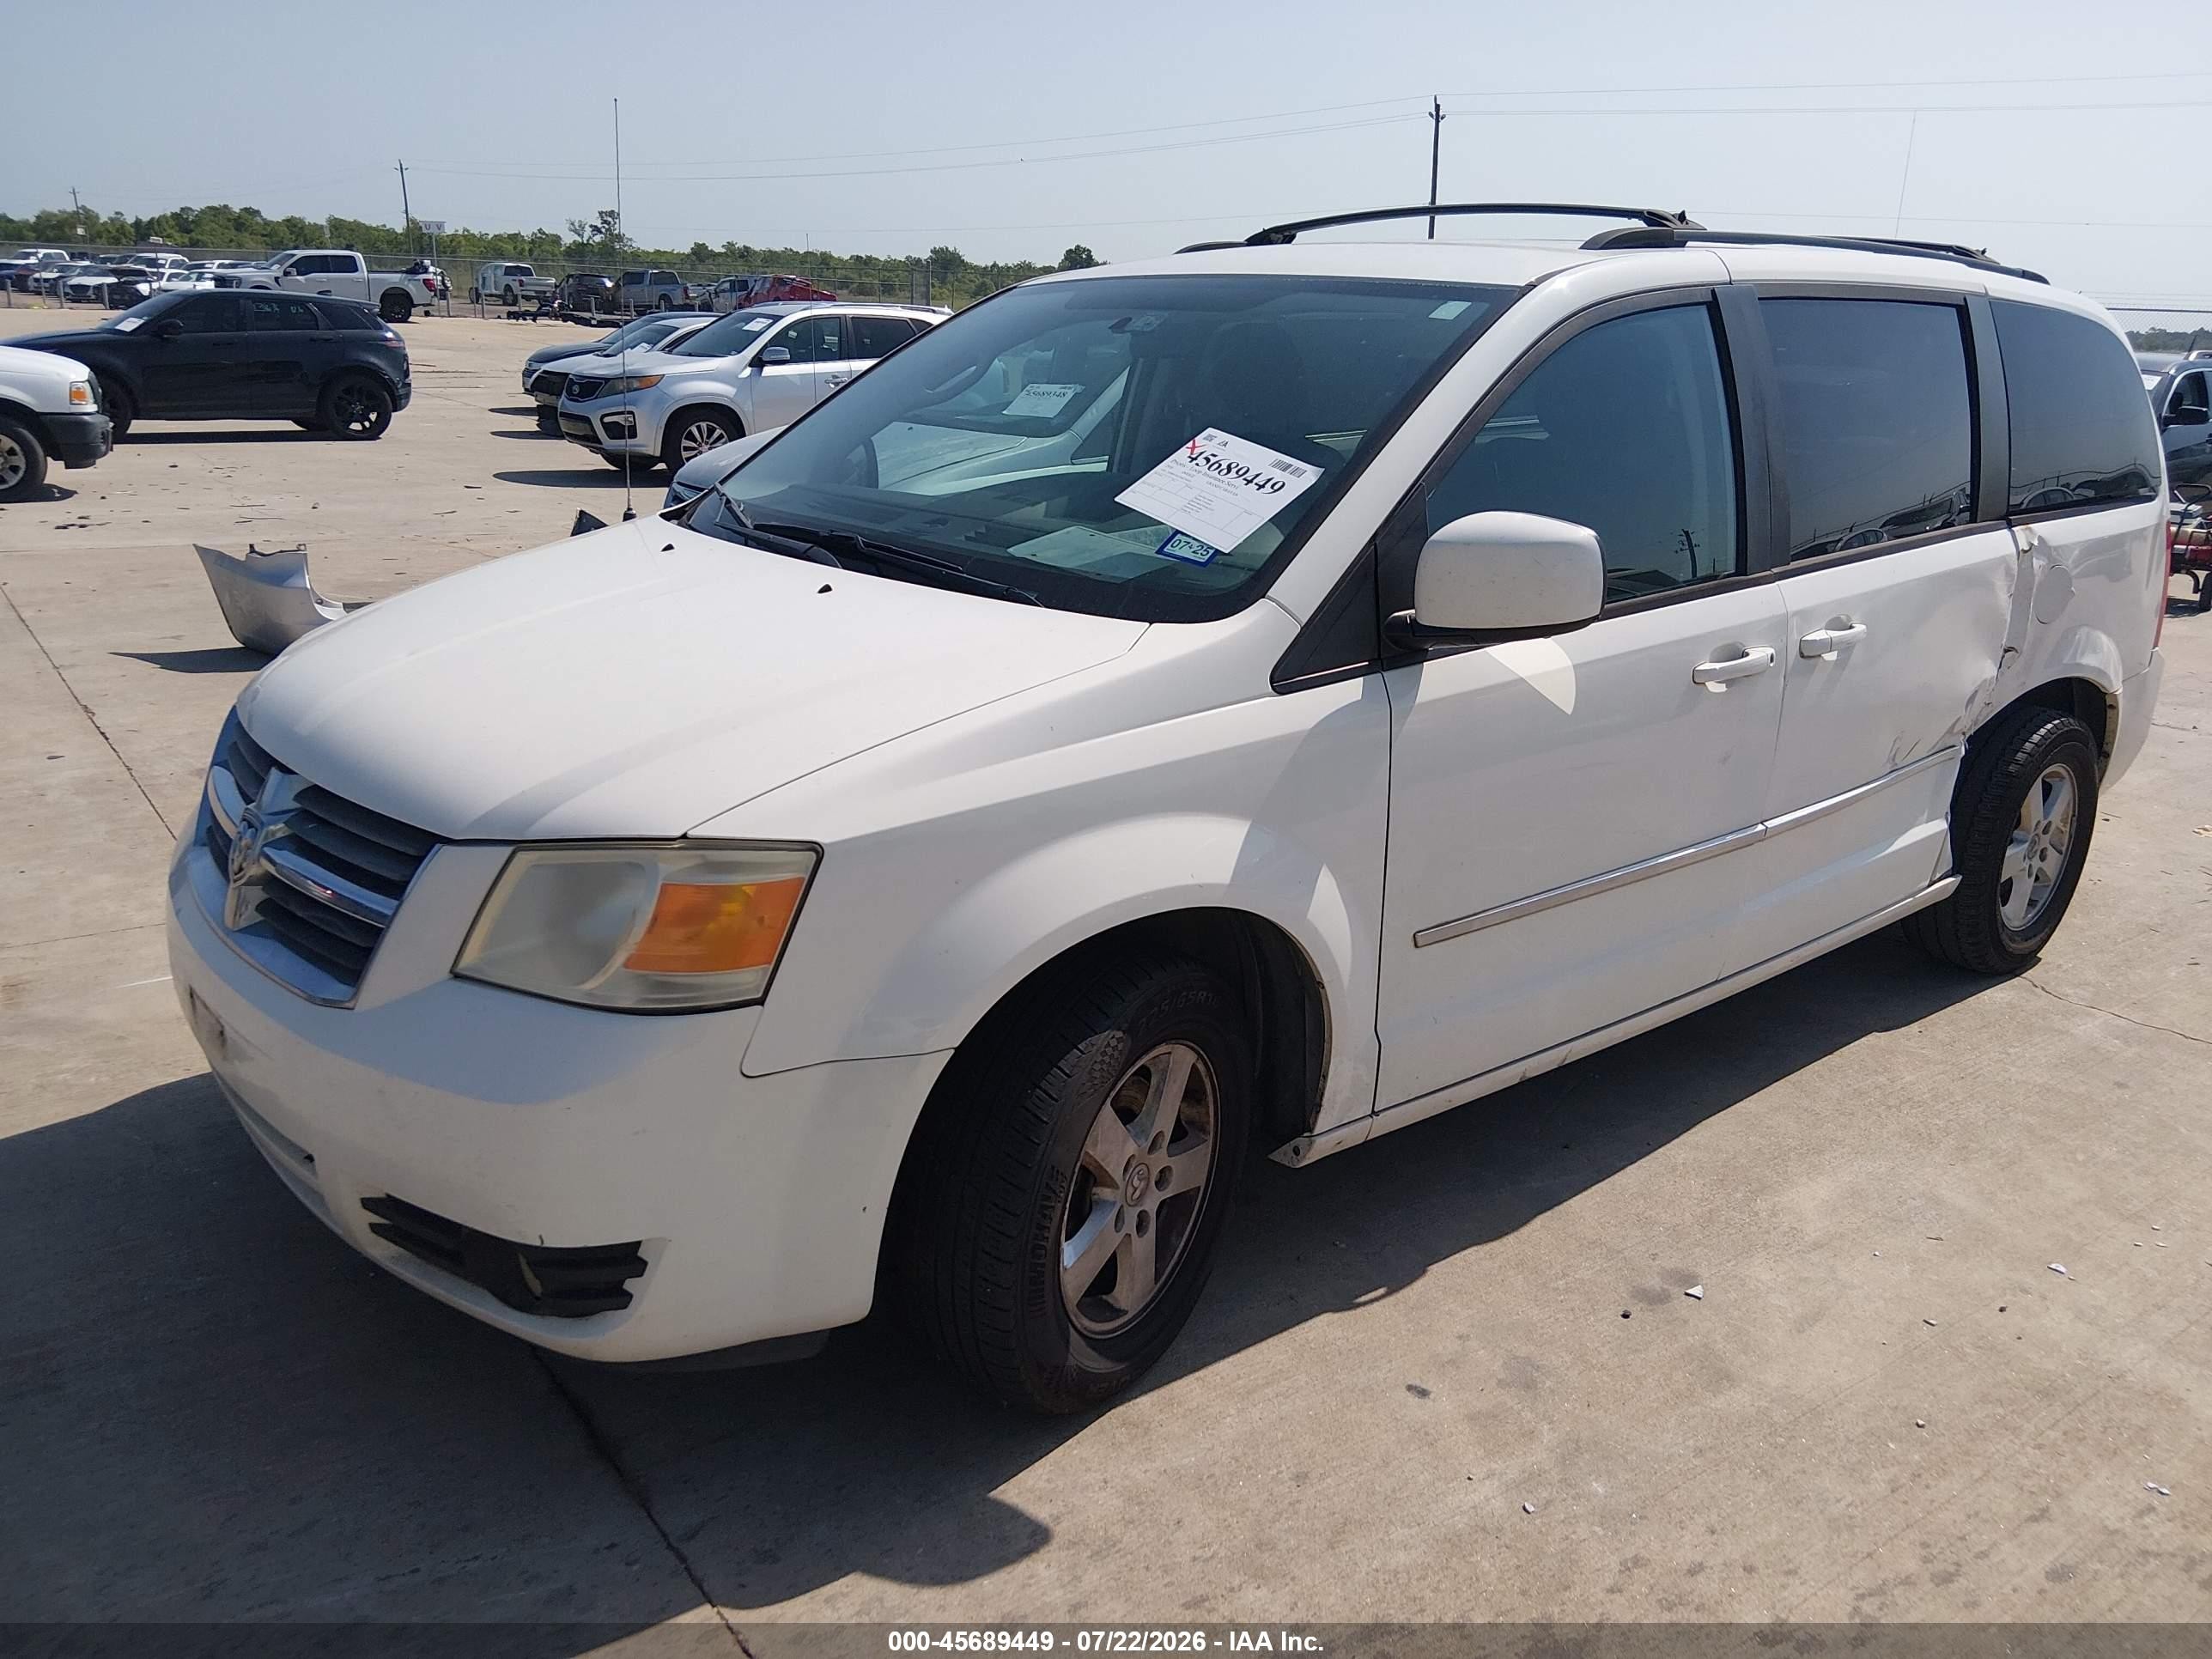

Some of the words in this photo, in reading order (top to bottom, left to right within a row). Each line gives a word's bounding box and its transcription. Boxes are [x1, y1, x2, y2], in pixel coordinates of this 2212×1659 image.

[1187, 450, 1286, 495] 45689449
[1170, 538, 1190, 550] 07
[1192, 544, 1213, 556] 25
